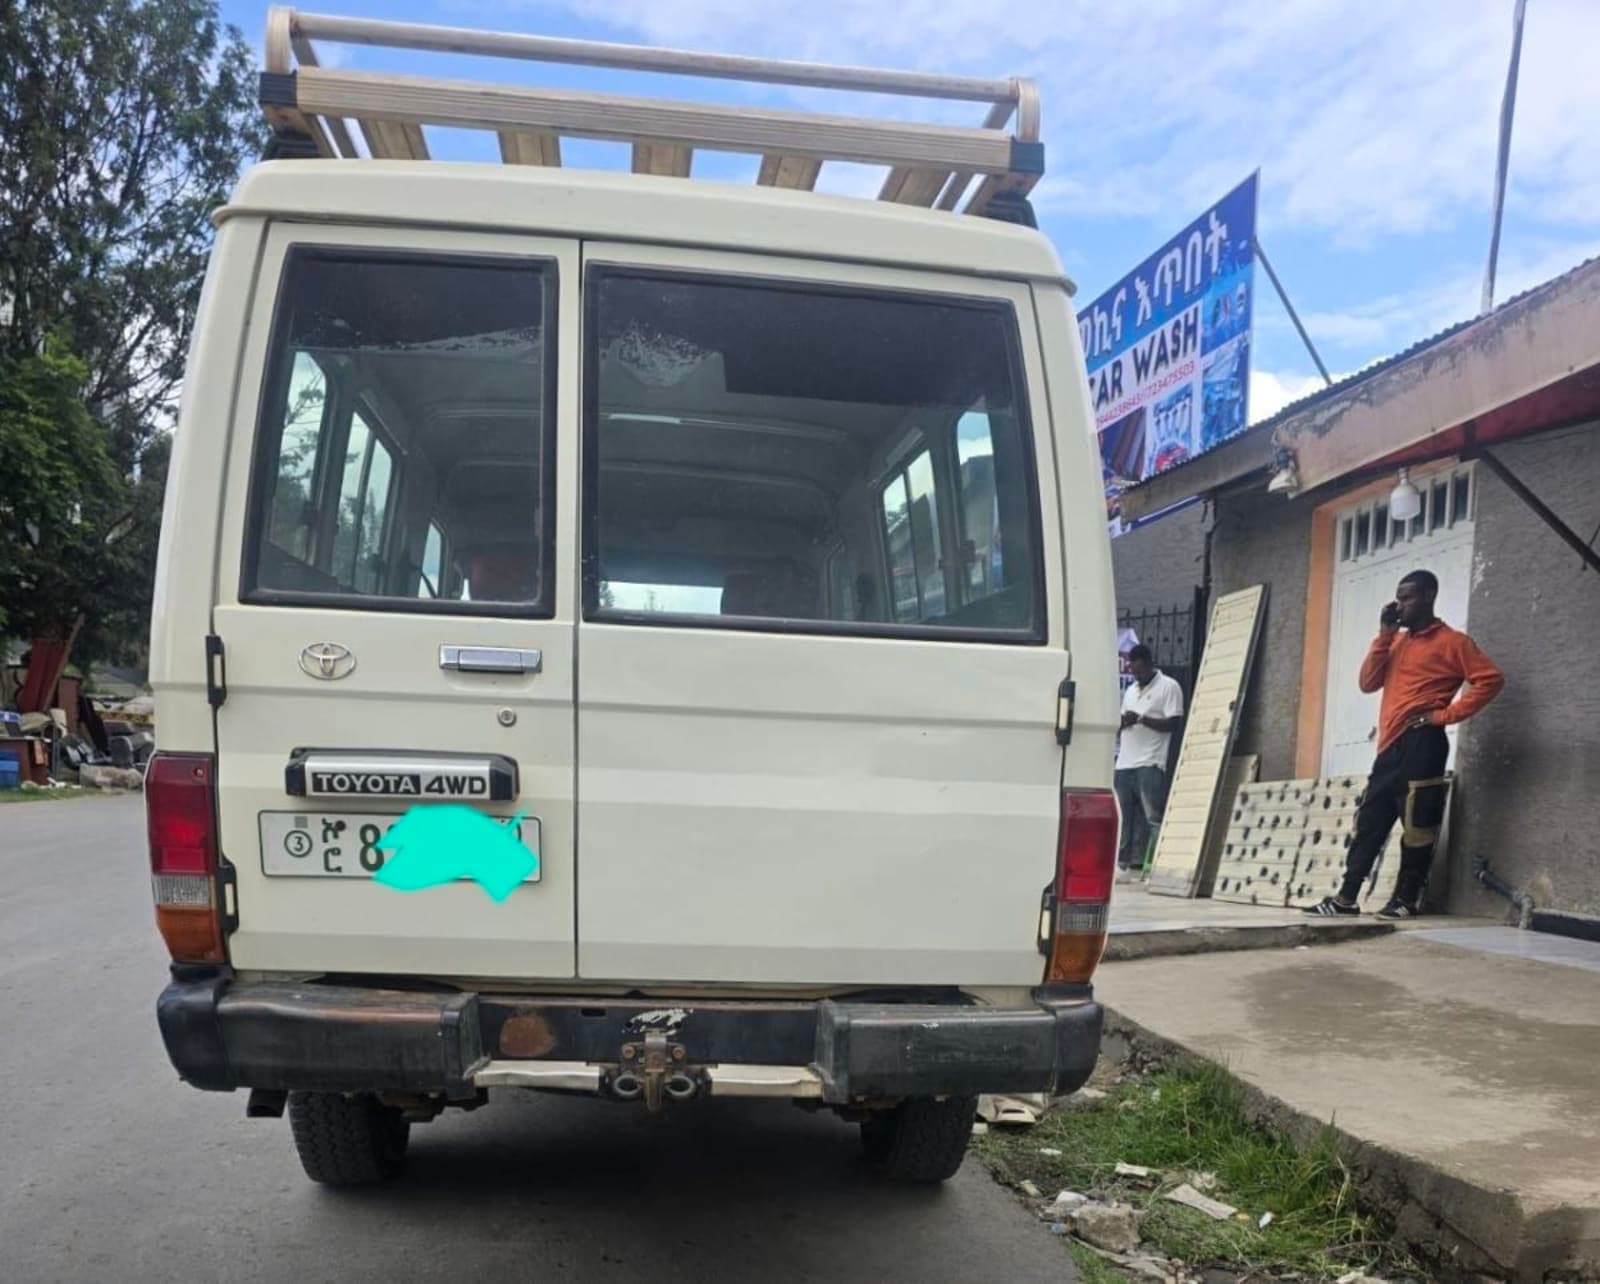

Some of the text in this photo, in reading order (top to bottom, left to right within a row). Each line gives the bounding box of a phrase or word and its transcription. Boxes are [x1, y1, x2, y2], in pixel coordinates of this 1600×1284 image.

[1132, 306, 1198, 387] WASH
[316, 774, 487, 795] TOYOTA 4WD
[294, 835, 304, 853] 3
